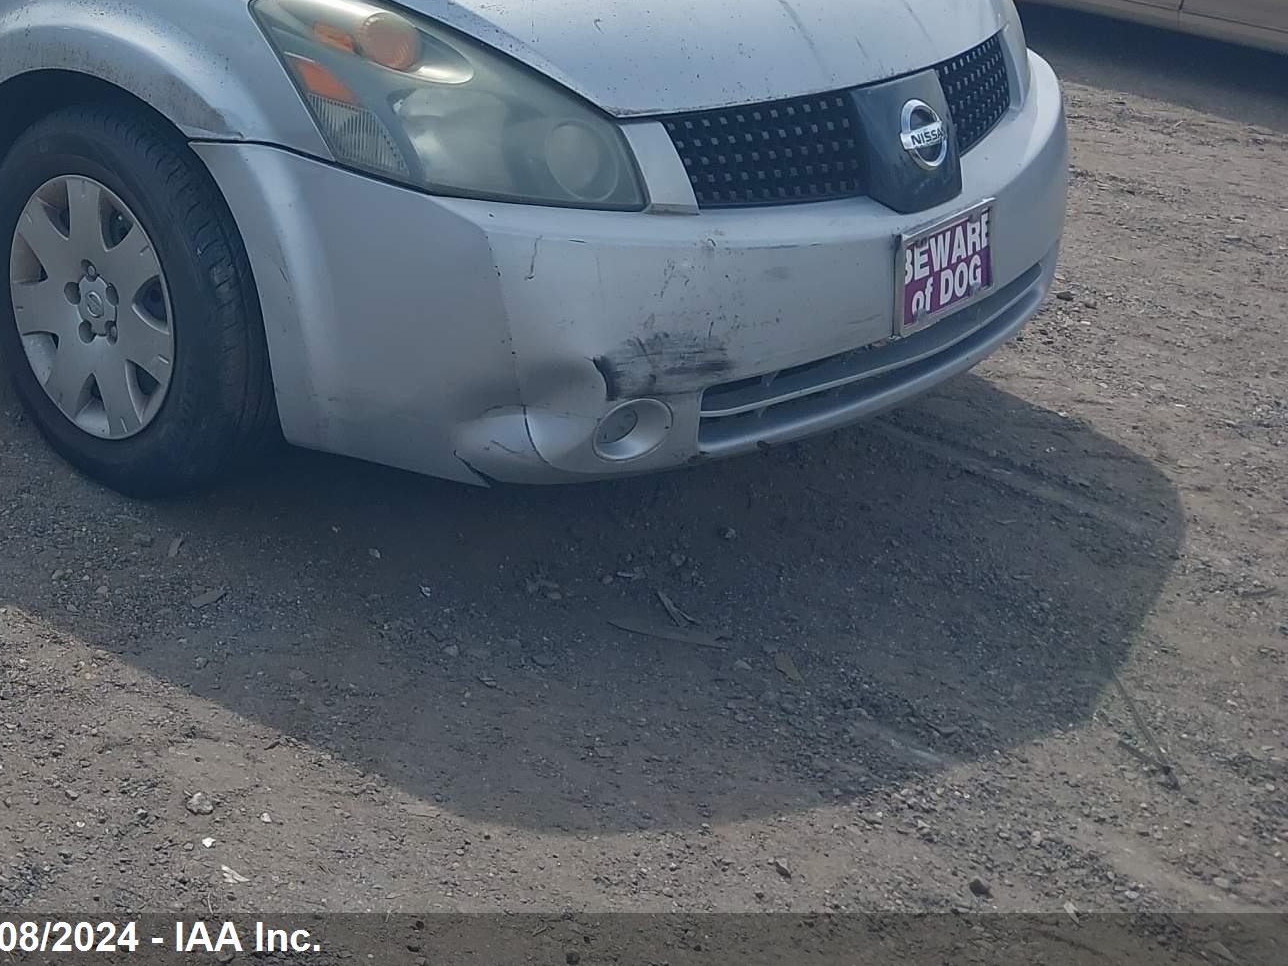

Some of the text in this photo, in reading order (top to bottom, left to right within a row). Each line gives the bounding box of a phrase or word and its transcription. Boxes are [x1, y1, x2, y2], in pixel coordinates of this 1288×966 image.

[911, 127, 945, 145] NISSA
[905, 213, 989, 285] BEWARE
[912, 254, 982, 315] of DOG
